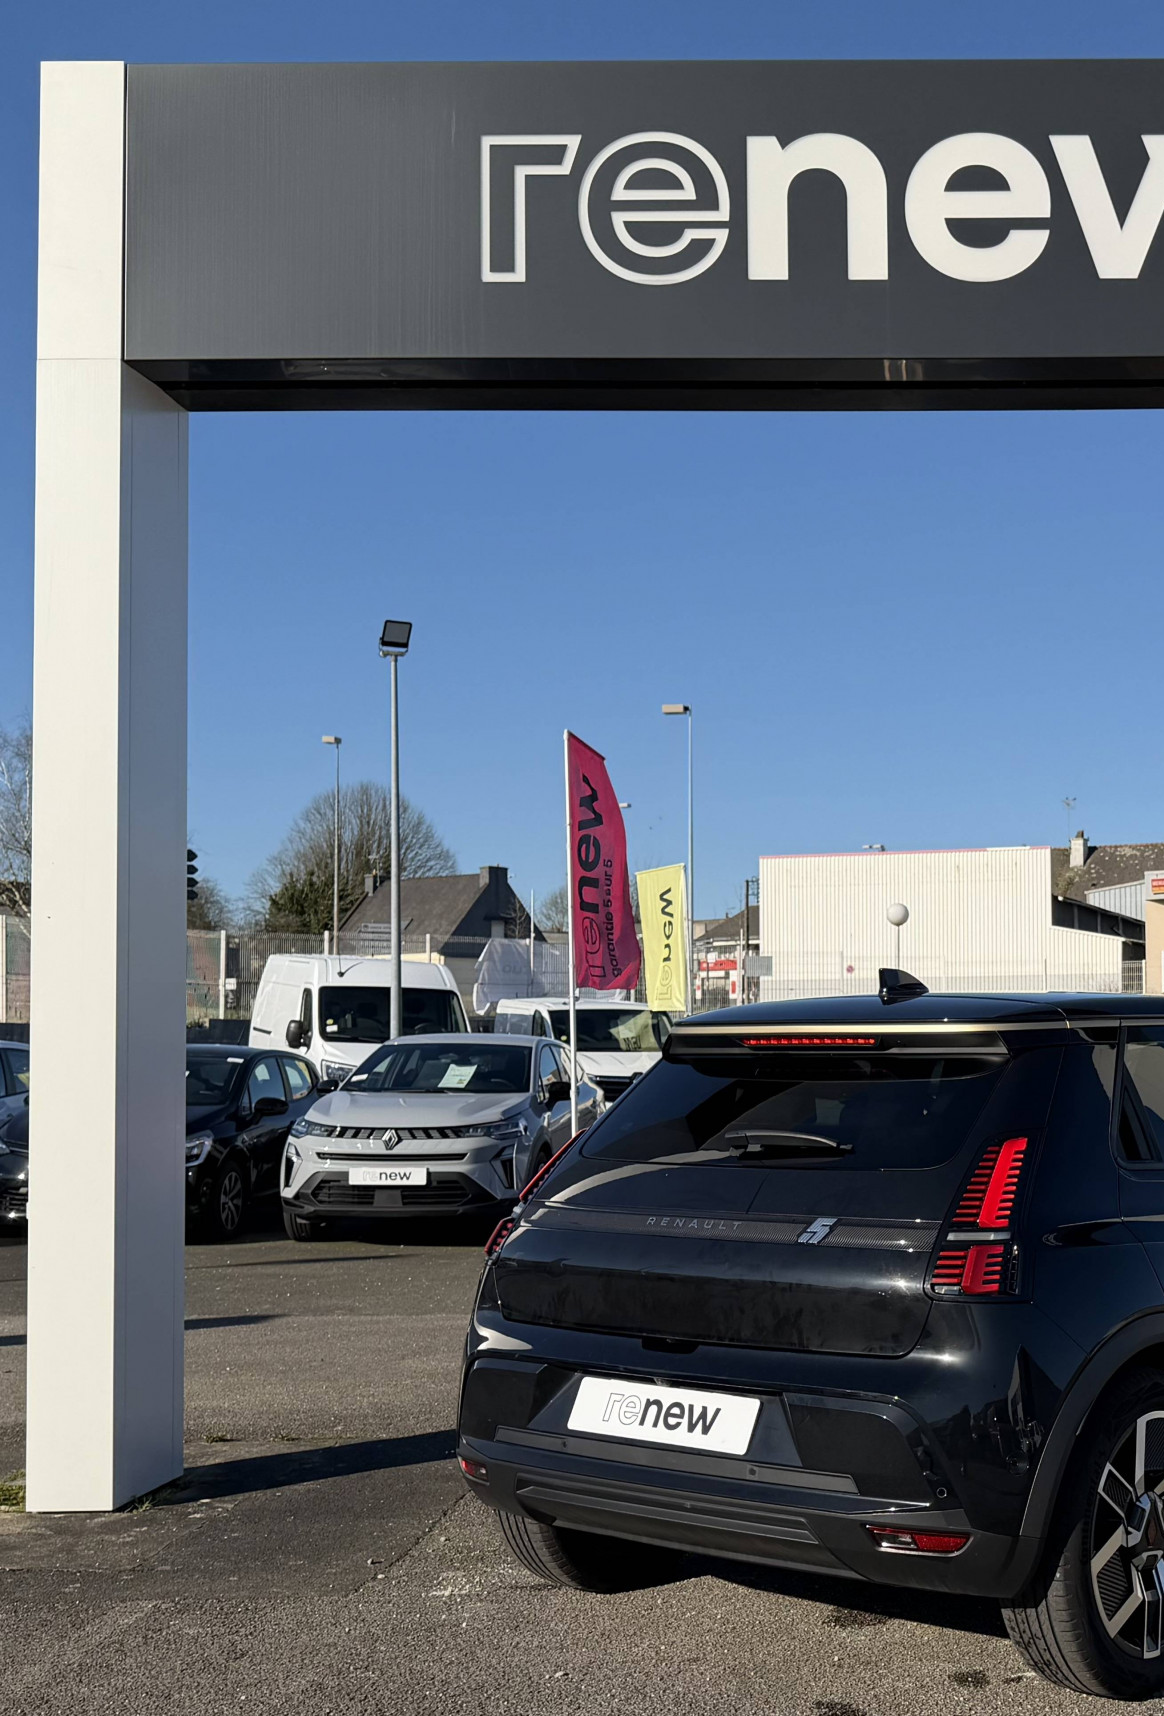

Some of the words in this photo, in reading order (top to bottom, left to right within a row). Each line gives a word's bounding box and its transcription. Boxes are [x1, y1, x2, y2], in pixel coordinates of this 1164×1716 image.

[577, 773, 606, 978] renew
[646, 1217, 742, 1231] RENAULT
[601, 1391, 722, 1437] renew
